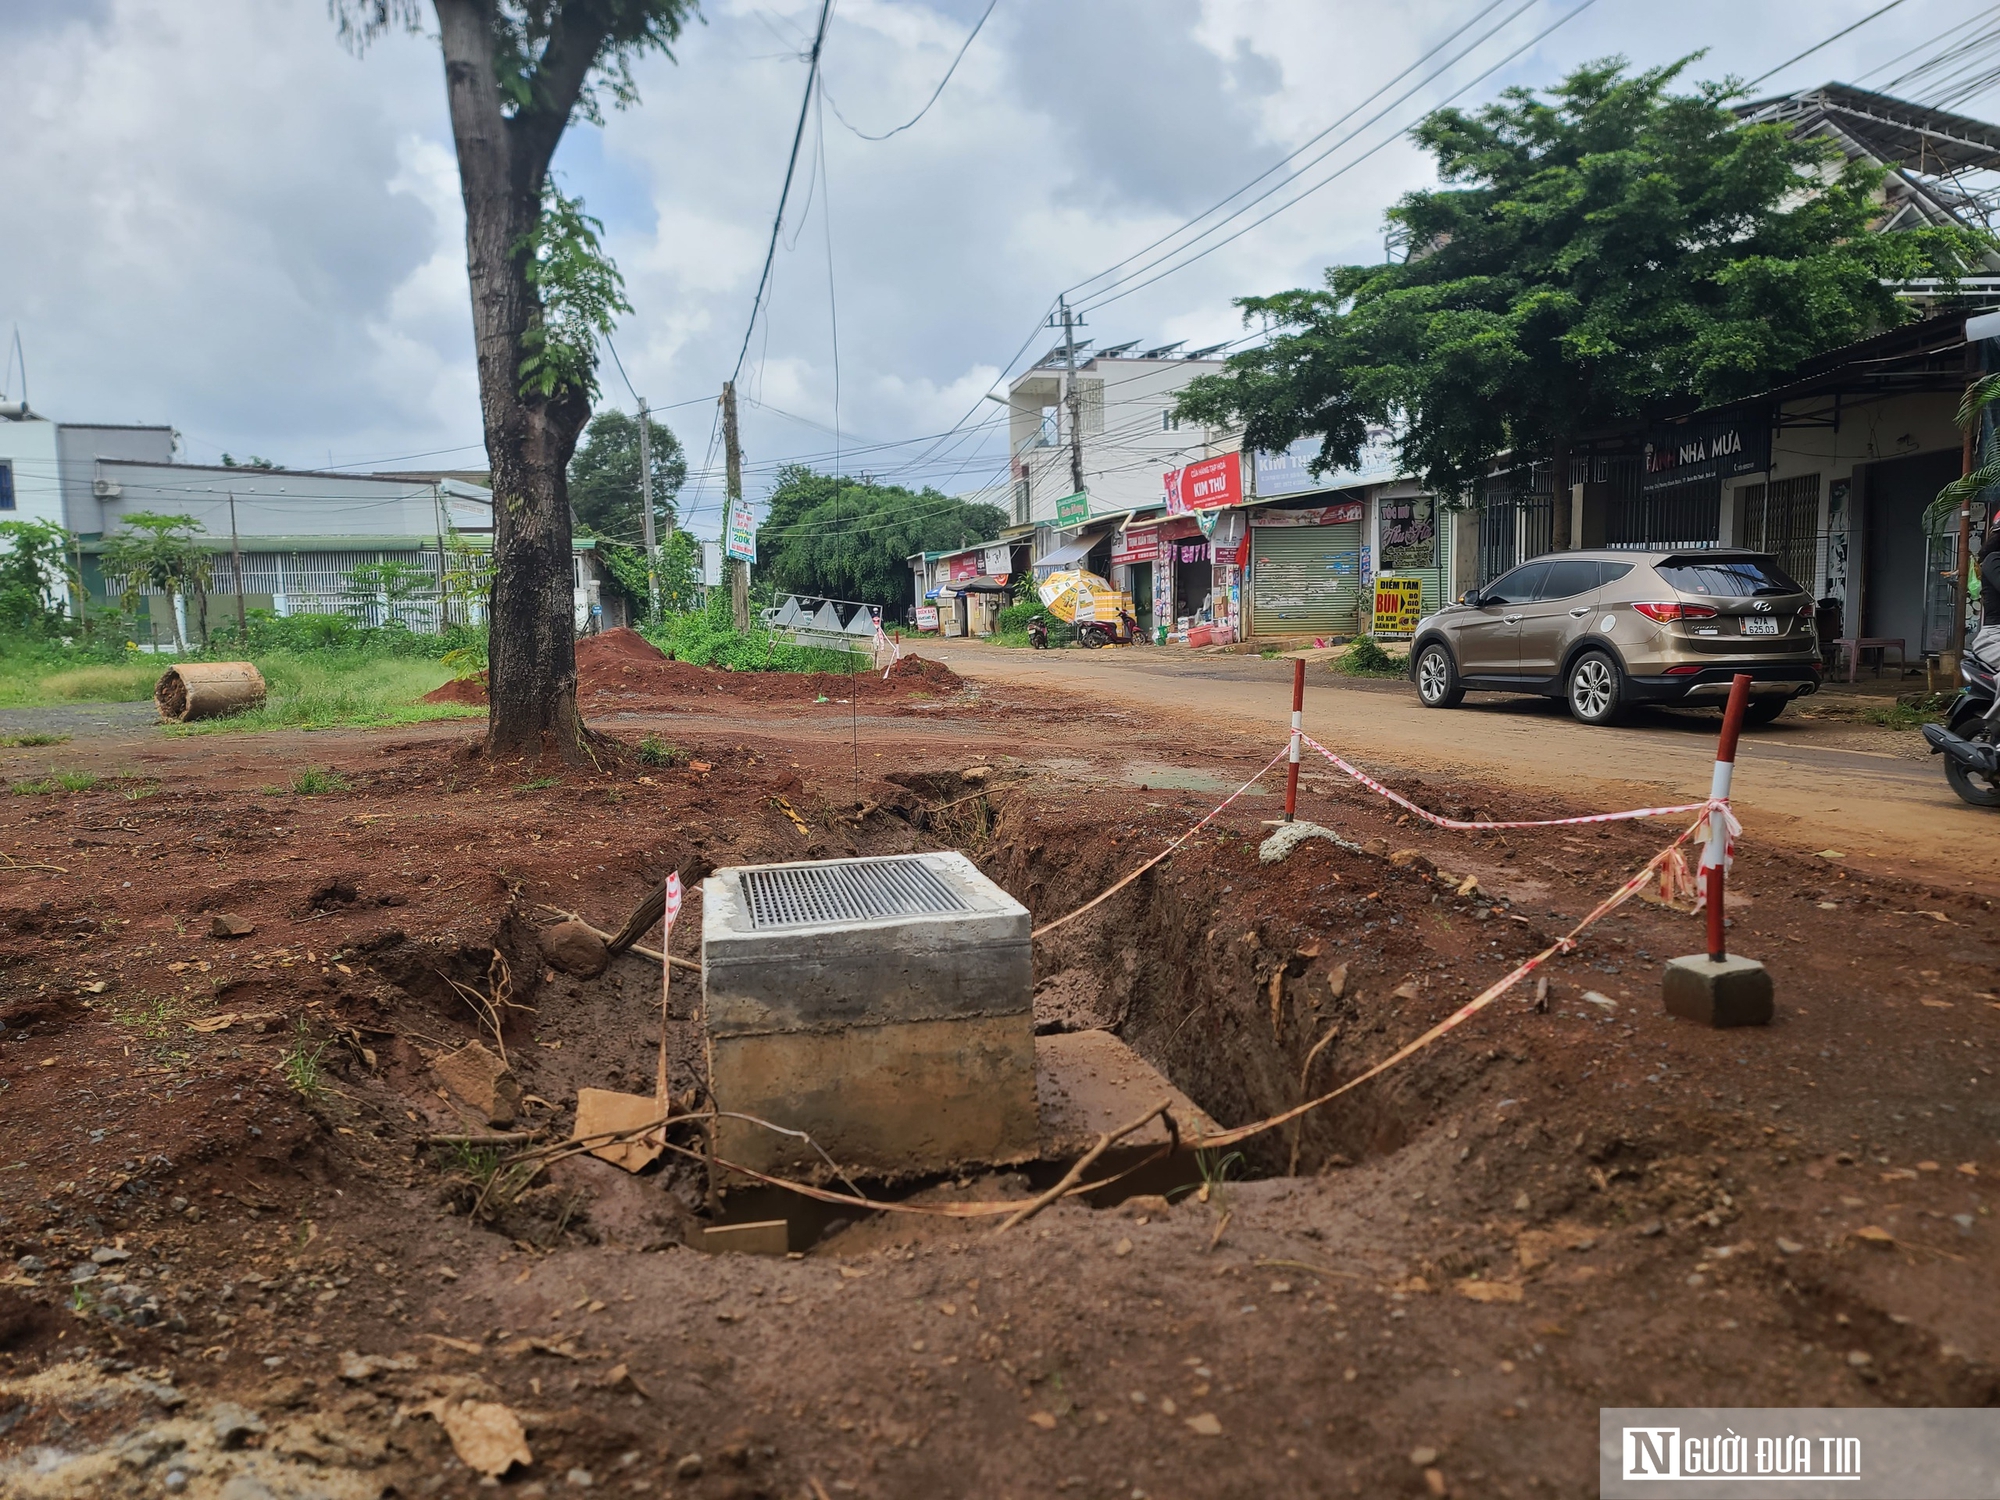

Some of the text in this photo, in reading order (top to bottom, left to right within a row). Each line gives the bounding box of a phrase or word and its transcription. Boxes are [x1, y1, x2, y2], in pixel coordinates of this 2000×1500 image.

[1679, 436, 1706, 465] NHÀ
[1711, 429, 1741, 458] MƯA
[1259, 457, 1286, 471] KIM
[1193, 472, 1226, 498] KIM THỨ
[1381, 504, 1396, 519] TÓC
[1382, 524, 1405, 546] Thu
[1401, 580, 1419, 590] TÂM
[1376, 590, 1399, 614] BÚN
[1753, 617, 1768, 625] 47A
[1748, 625, 1775, 634] 625.03
